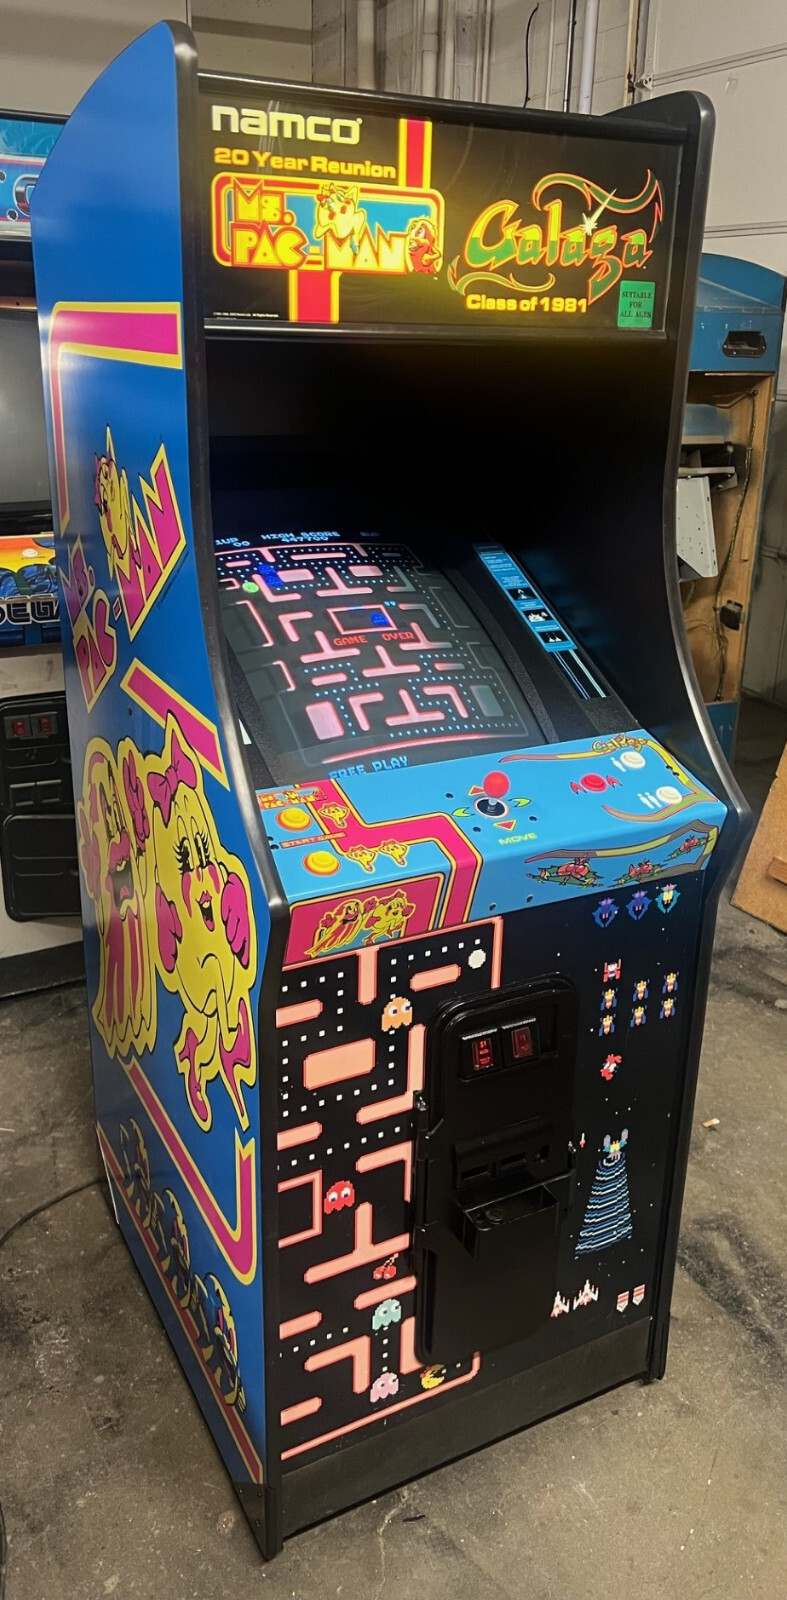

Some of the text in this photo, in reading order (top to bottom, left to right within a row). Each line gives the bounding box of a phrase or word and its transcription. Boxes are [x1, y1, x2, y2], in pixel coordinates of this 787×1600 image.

[212, 105, 360, 145] namco
[214, 147, 397, 179] 20 Year Reunion
[464, 198, 654, 305] Galaga
[465, 293, 588, 313] Class of 1981
[621, 290, 652, 300] SUITABLE
[628, 301, 643, 310] FOR
[619, 310, 652, 320] ALL AGES
[214, 537, 239, 546] 1UP
[333, 631, 415, 647] GAME OVER
[329, 756, 408, 779] FREE PLAY
[498, 832, 538, 845] MOVE
